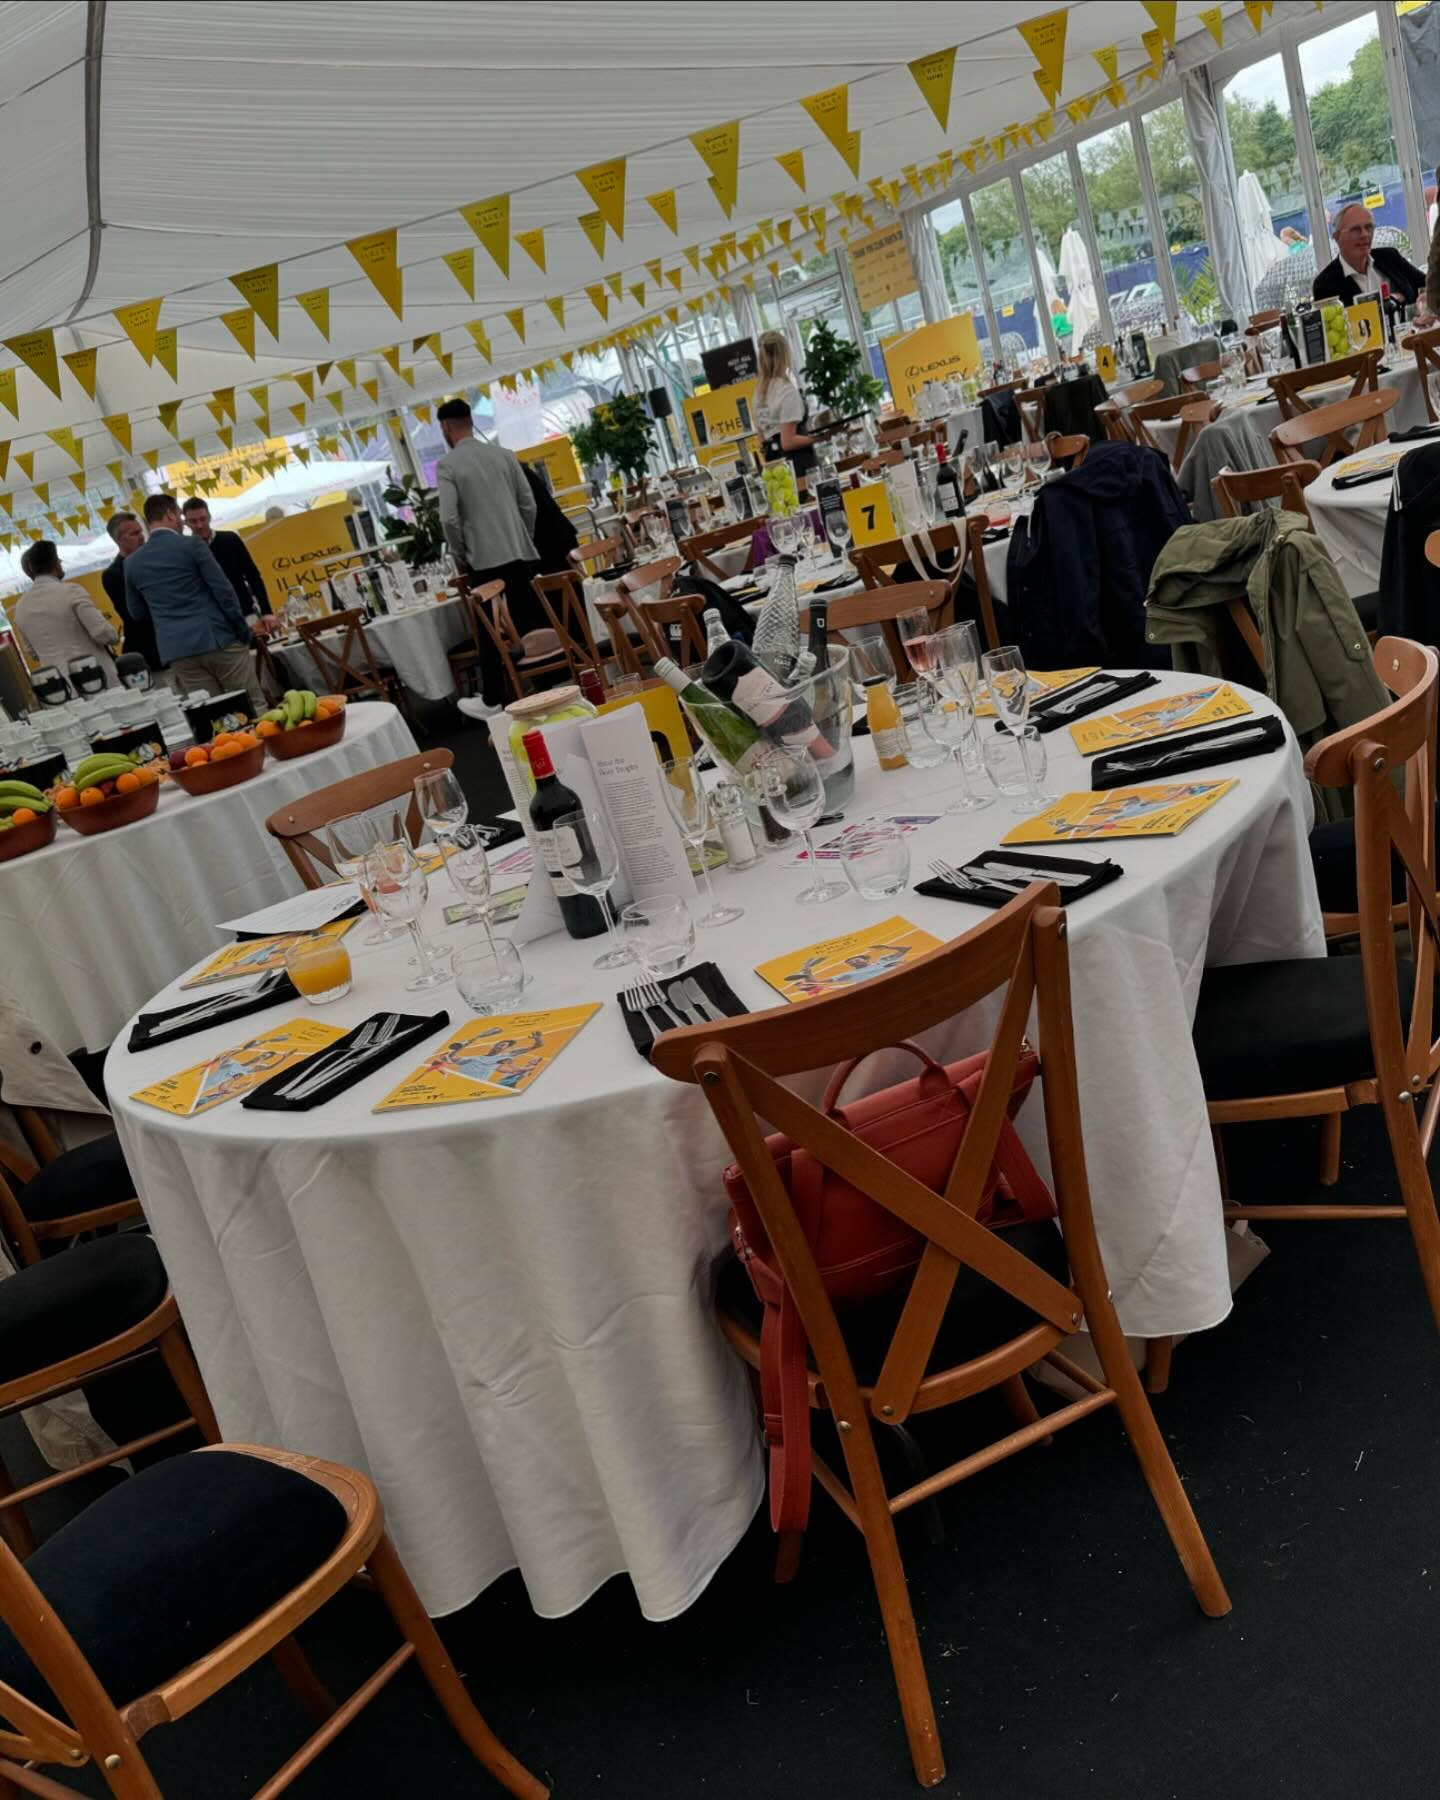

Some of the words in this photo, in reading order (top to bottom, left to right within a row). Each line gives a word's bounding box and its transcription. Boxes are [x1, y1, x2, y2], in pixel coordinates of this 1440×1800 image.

[920, 354, 961, 373] LEXUS
[861, 504, 875, 531] 7
[291, 545, 342, 565] LEXUS
